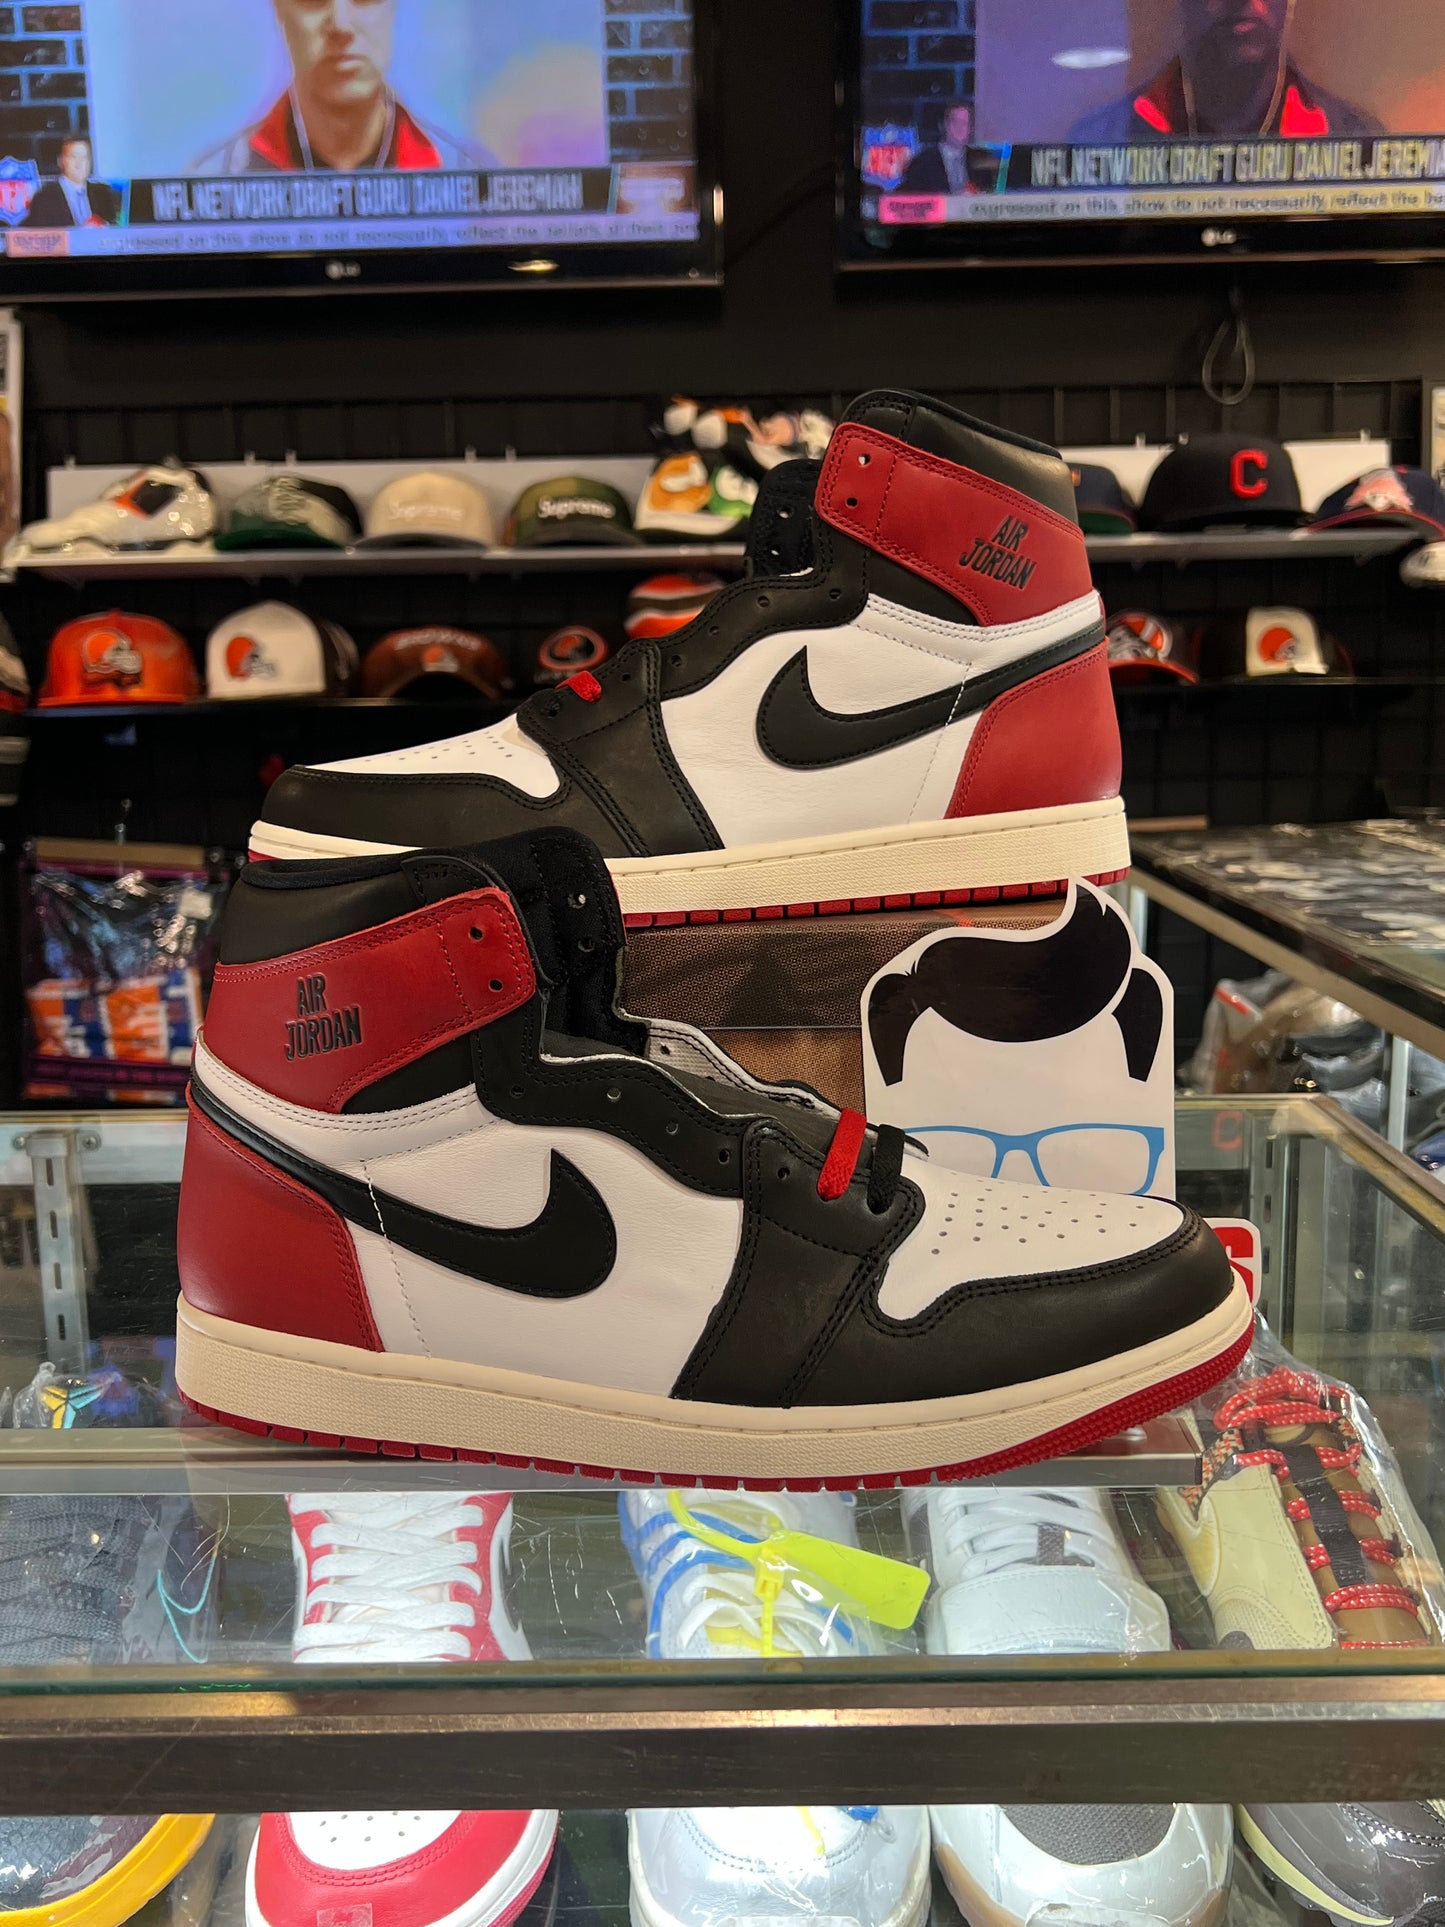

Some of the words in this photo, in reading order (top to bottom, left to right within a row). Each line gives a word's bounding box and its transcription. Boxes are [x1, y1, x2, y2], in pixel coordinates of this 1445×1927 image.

[1031, 147, 1070, 187] NFL
[1071, 145, 1169, 186] NETWORK
[1170, 144, 1235, 184] DRAFT
[1236, 142, 1293, 182] GURU
[1294, 141, 1363, 181] DANIEL
[152, 181, 193, 221] NFL
[193, 179, 289, 220] NETWORK
[291, 177, 354, 218] DRAFT
[355, 176, 411, 216] GURU
[413, 174, 479, 214] DANIEL
[480, 172, 584, 212] JEREMIAH
[1229, 447, 1268, 499] C
[388, 500, 465, 521] Supreme
[537, 495, 616, 519] Supreme
[991, 515, 1029, 552] AIR
[959, 537, 1037, 590] JORDAN
[297, 972, 327, 1017] AIR
[284, 1004, 362, 1062] JORDAN
